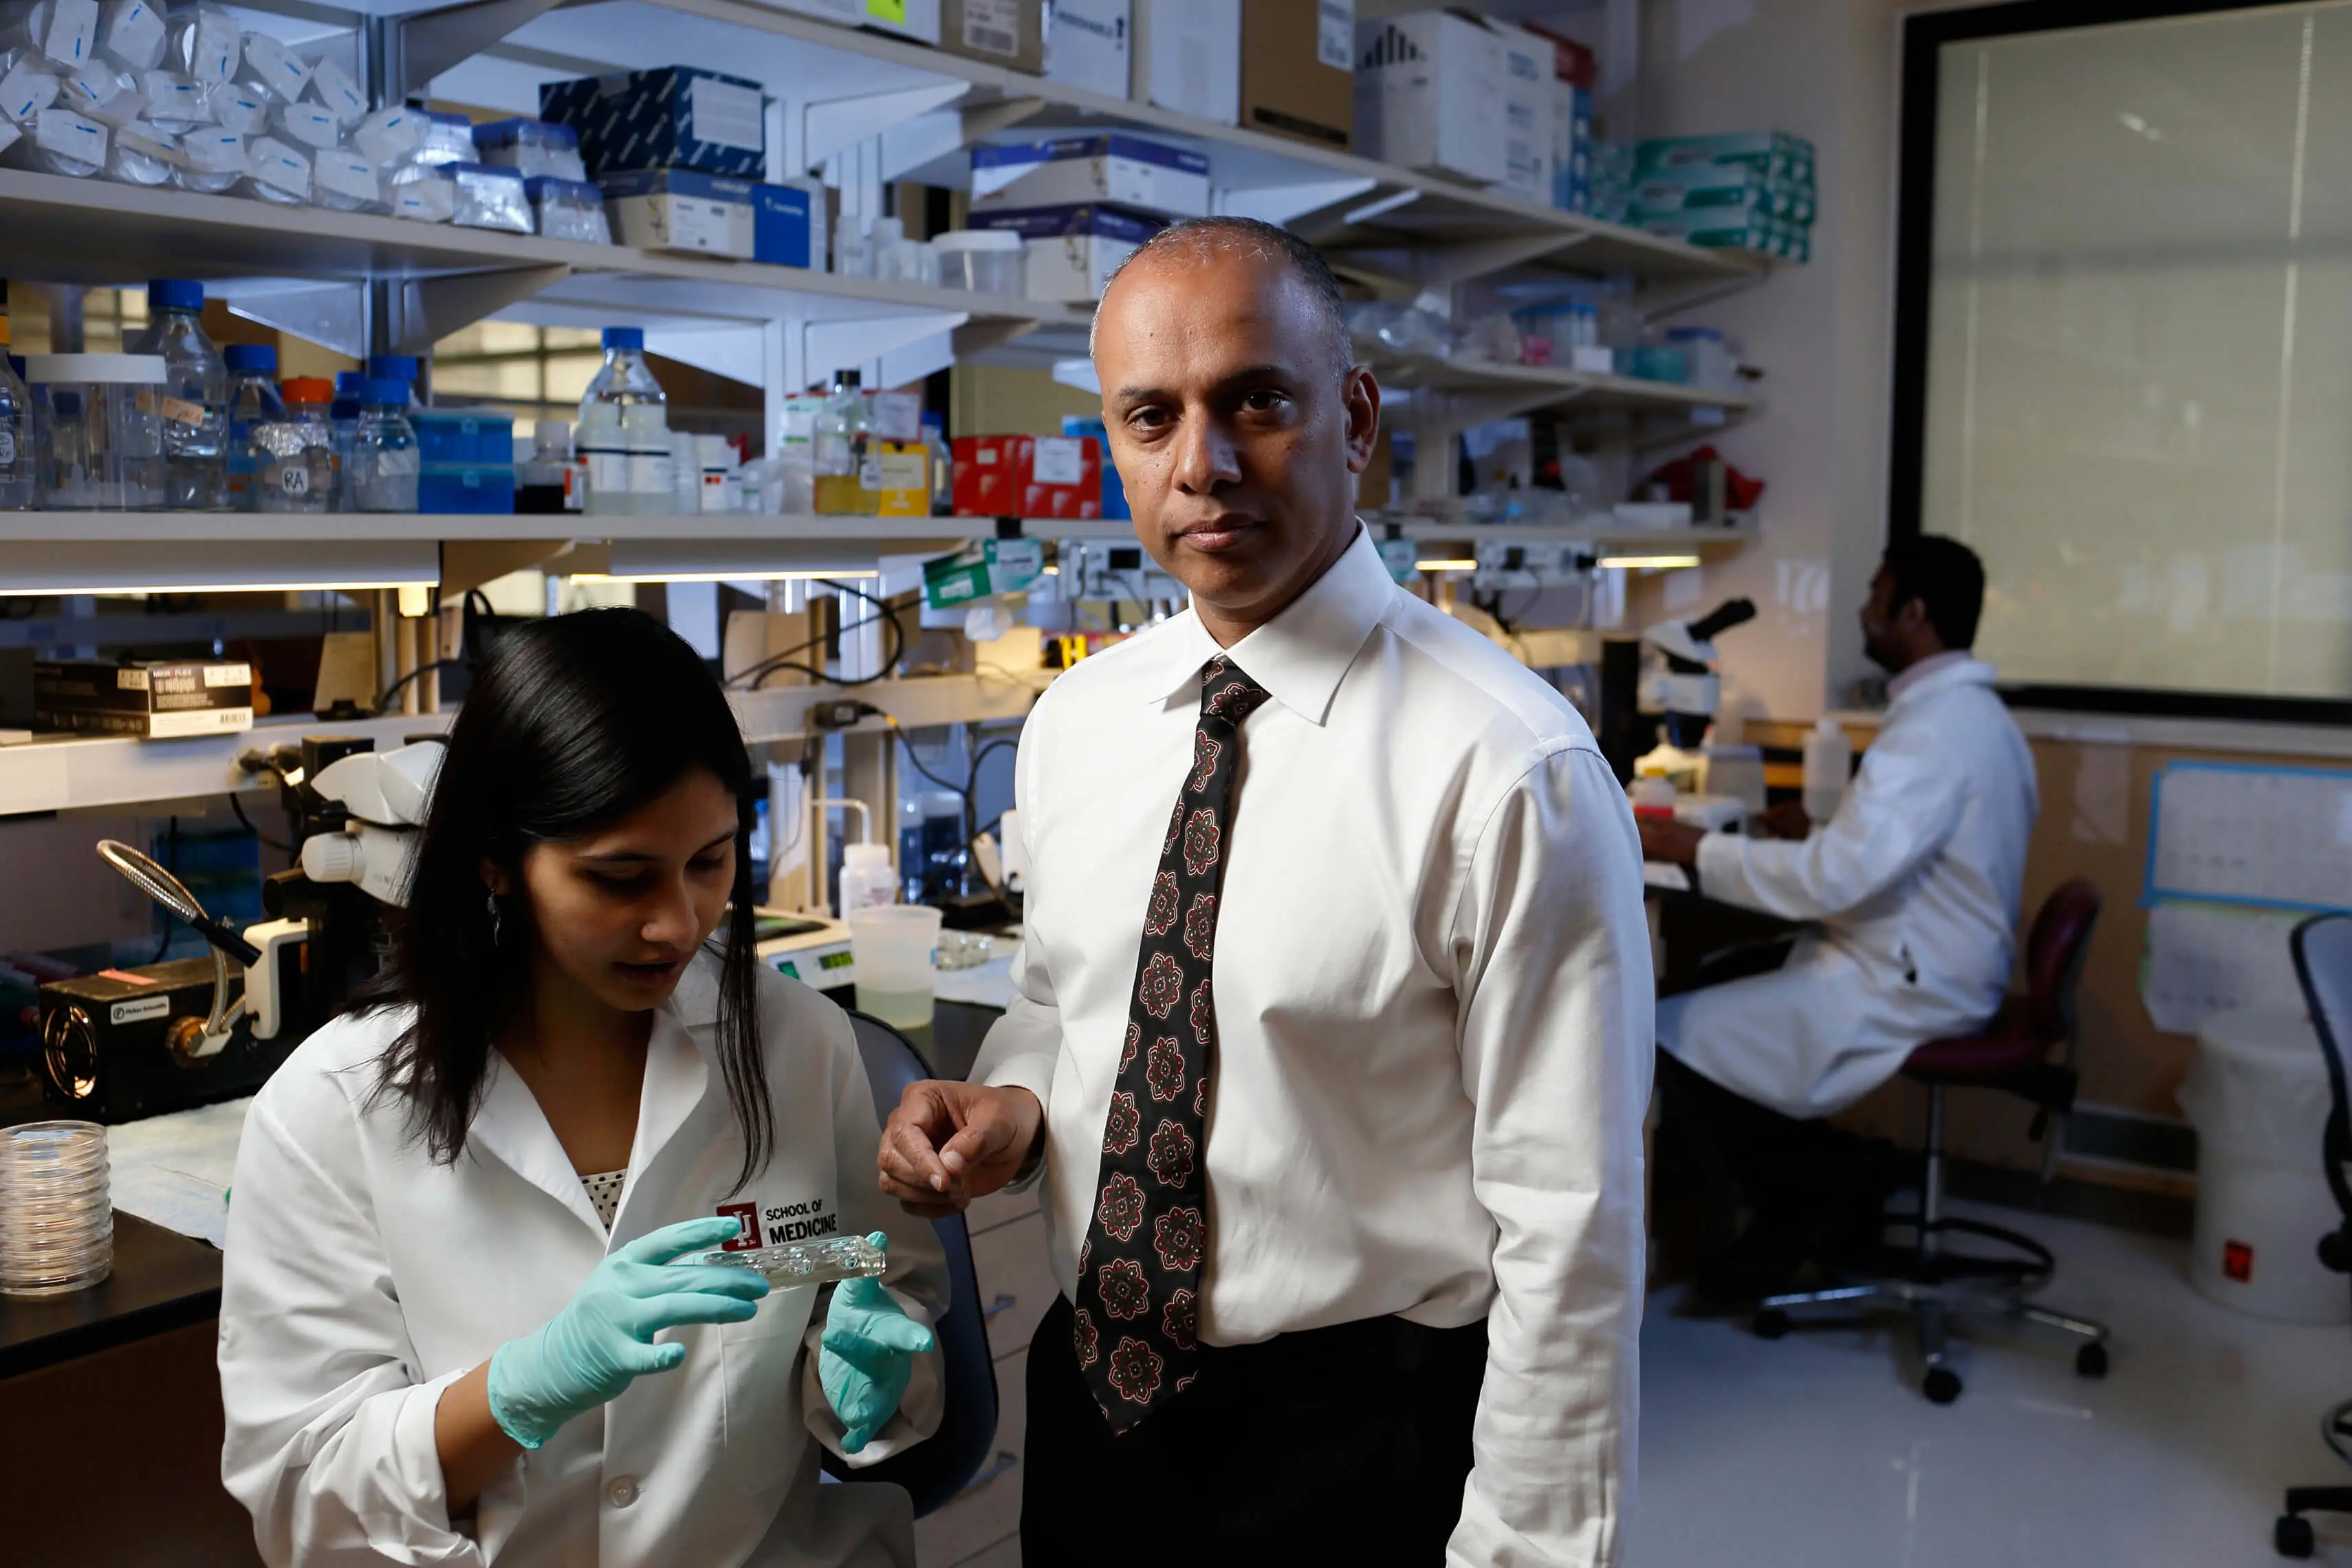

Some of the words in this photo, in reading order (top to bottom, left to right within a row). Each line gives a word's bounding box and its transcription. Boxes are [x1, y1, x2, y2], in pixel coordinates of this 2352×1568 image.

[284, 471, 304, 489] RA
[765, 1202, 810, 1221] SCHOOL
[812, 1199, 823, 1212] OF
[769, 1214, 838, 1245] MEDICINE
